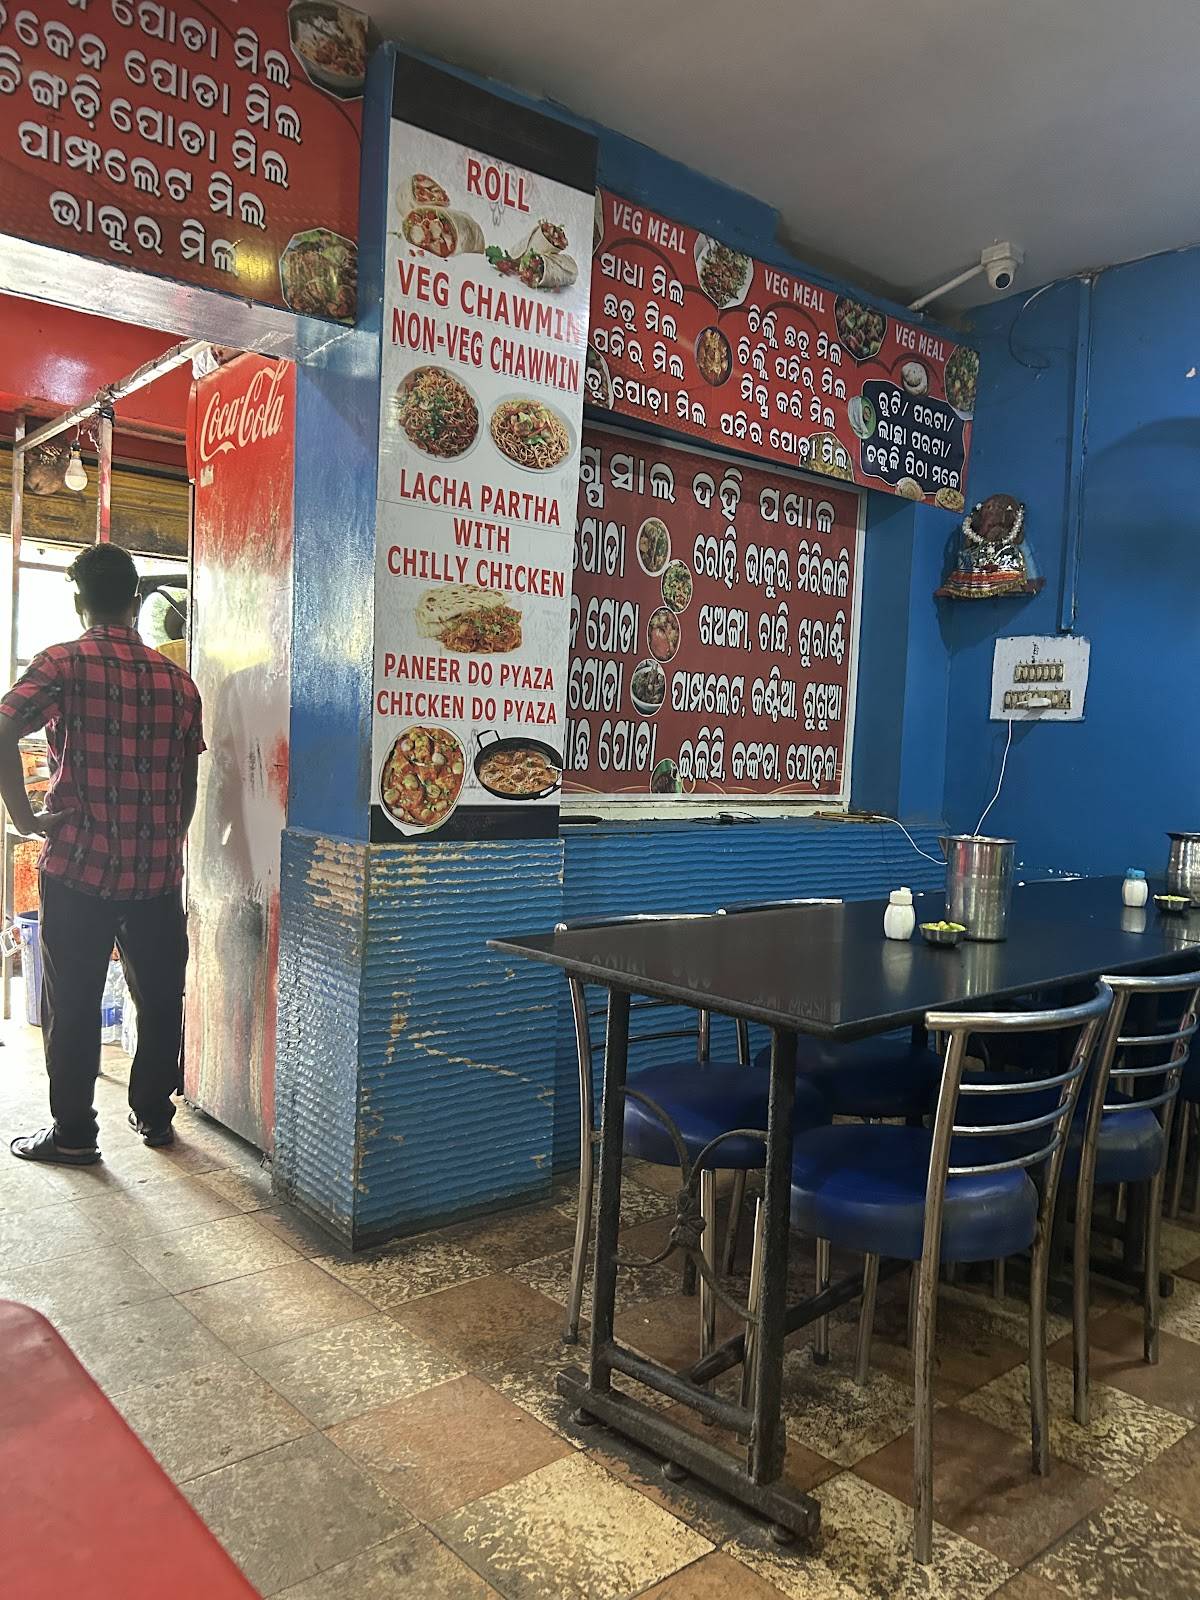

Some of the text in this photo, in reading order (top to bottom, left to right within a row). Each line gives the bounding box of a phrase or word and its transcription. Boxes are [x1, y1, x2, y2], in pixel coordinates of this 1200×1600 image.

[234, 27, 292, 89] ମିଲ
[125, 50, 230, 115] ପୋଡା
[246, 83, 303, 144] ମିଲ
[110, 98, 217, 161] ପୋଡା
[232, 129, 289, 189] ମିଲ
[208, 171, 266, 229] ମିଲ
[466, 158, 531, 213] ROLL
[50, 190, 239, 276] ଭାକୁର ମିଲ
[613, 200, 686, 254] VEG MEAL
[397, 258, 583, 345] VEG CHAWMIN
[600, 252, 684, 306] ସାଧା ମିଲ
[764, 269, 825, 313] VEG MEAL
[603, 293, 677, 341] ଛତୁ ମିଲ
[895, 324, 945, 362] VEG MEAL
[391, 307, 581, 394] NON-VEG CHAWMIN
[653, 341, 685, 380] ମିଲ
[784, 325, 810, 359] ଛତୁ
[816, 331, 842, 366] ମିଲ
[676, 389, 707, 427] ମିଲ
[776, 389, 802, 419] କରି
[809, 396, 836, 430] ମିଲ
[821, 366, 847, 401] ମିଲ
[200, 359, 289, 462] Coca-Cola
[821, 437, 847, 470] ମିଲ
[400, 469, 561, 527] LACHA PARTHA
[692, 467, 743, 521] ଦହି
[759, 487, 835, 533] ପଖାଳ
[453, 518, 511, 554] WITH
[387, 545, 566, 598] CHILLY CHICKEN
[384, 653, 555, 691] PANEER DO PYAZA
[376, 690, 558, 725] CHICKEN DO PYAZA
